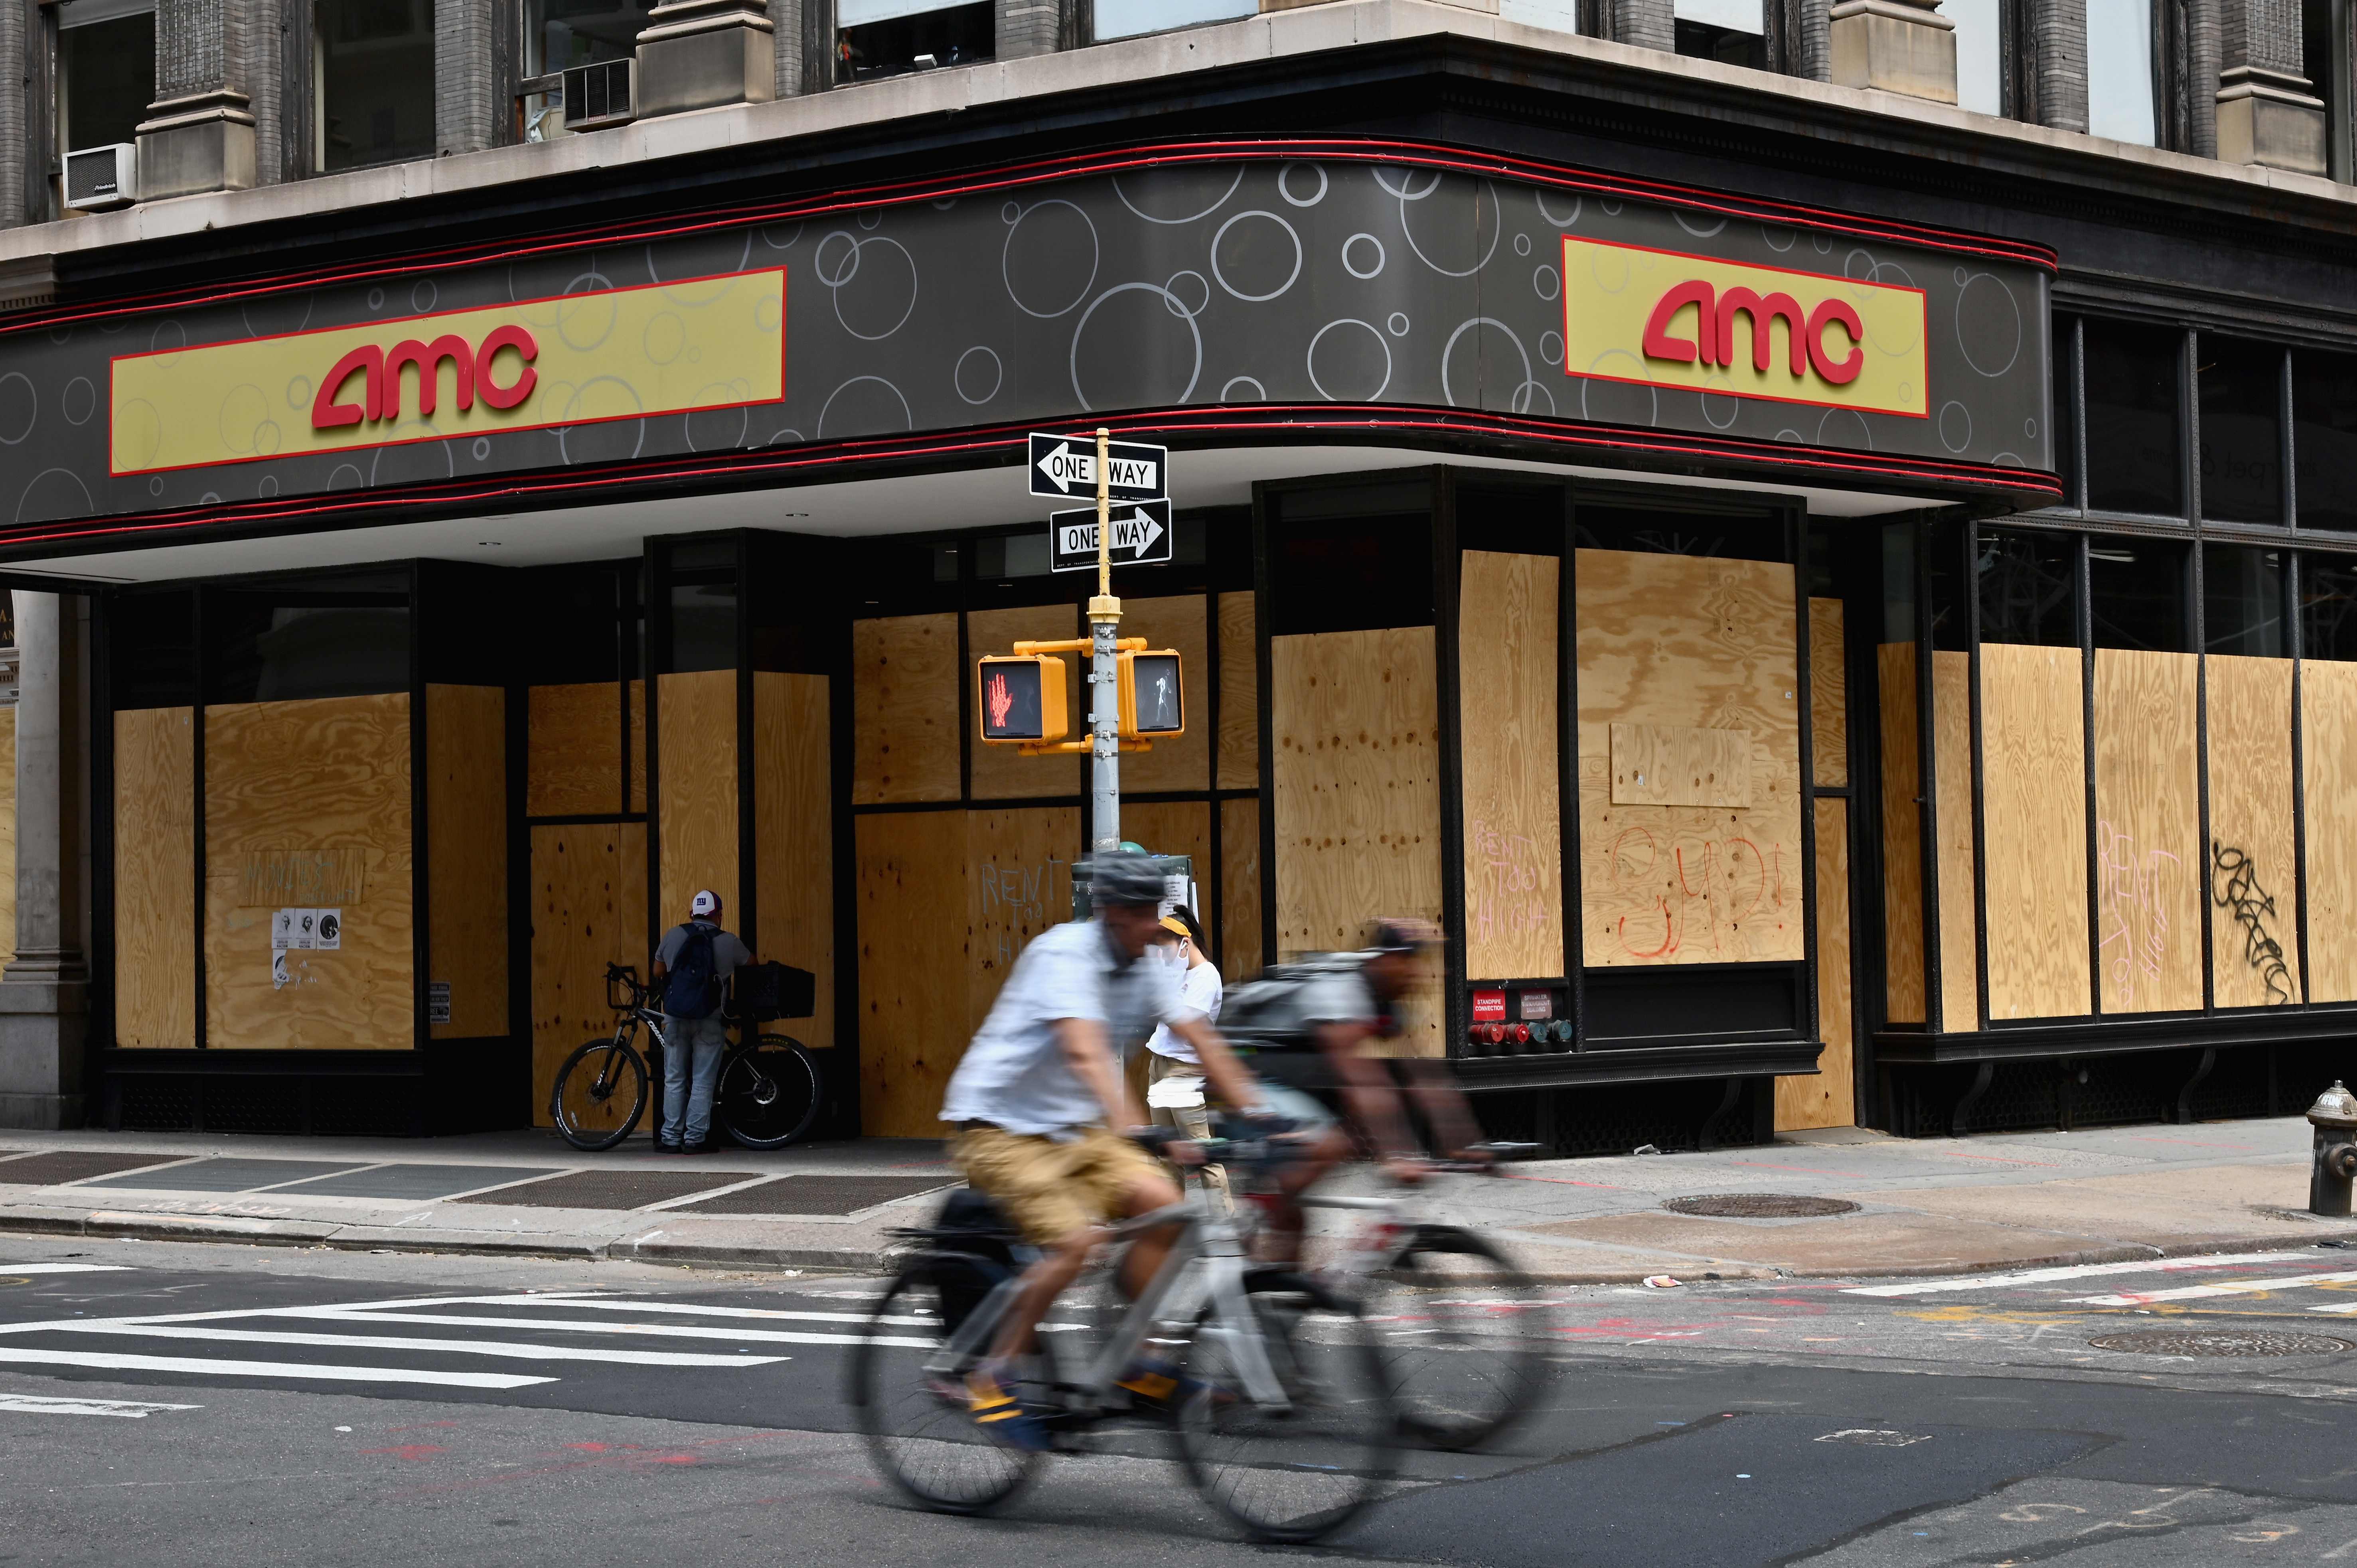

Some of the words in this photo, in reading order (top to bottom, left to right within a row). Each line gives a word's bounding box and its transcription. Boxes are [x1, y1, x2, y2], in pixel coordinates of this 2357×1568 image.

[1052, 456, 1088, 480] ONE
[1109, 462, 1148, 485] WAY
[1069, 527, 1099, 550] ONE
[1117, 521, 1151, 545] WAY
[1473, 820, 1532, 860] RENT
[981, 857, 1064, 913] RENT
[1490, 862, 1536, 897] TOO
[2100, 818, 2182, 914] RENT
[1479, 888, 1549, 943] HIGH
